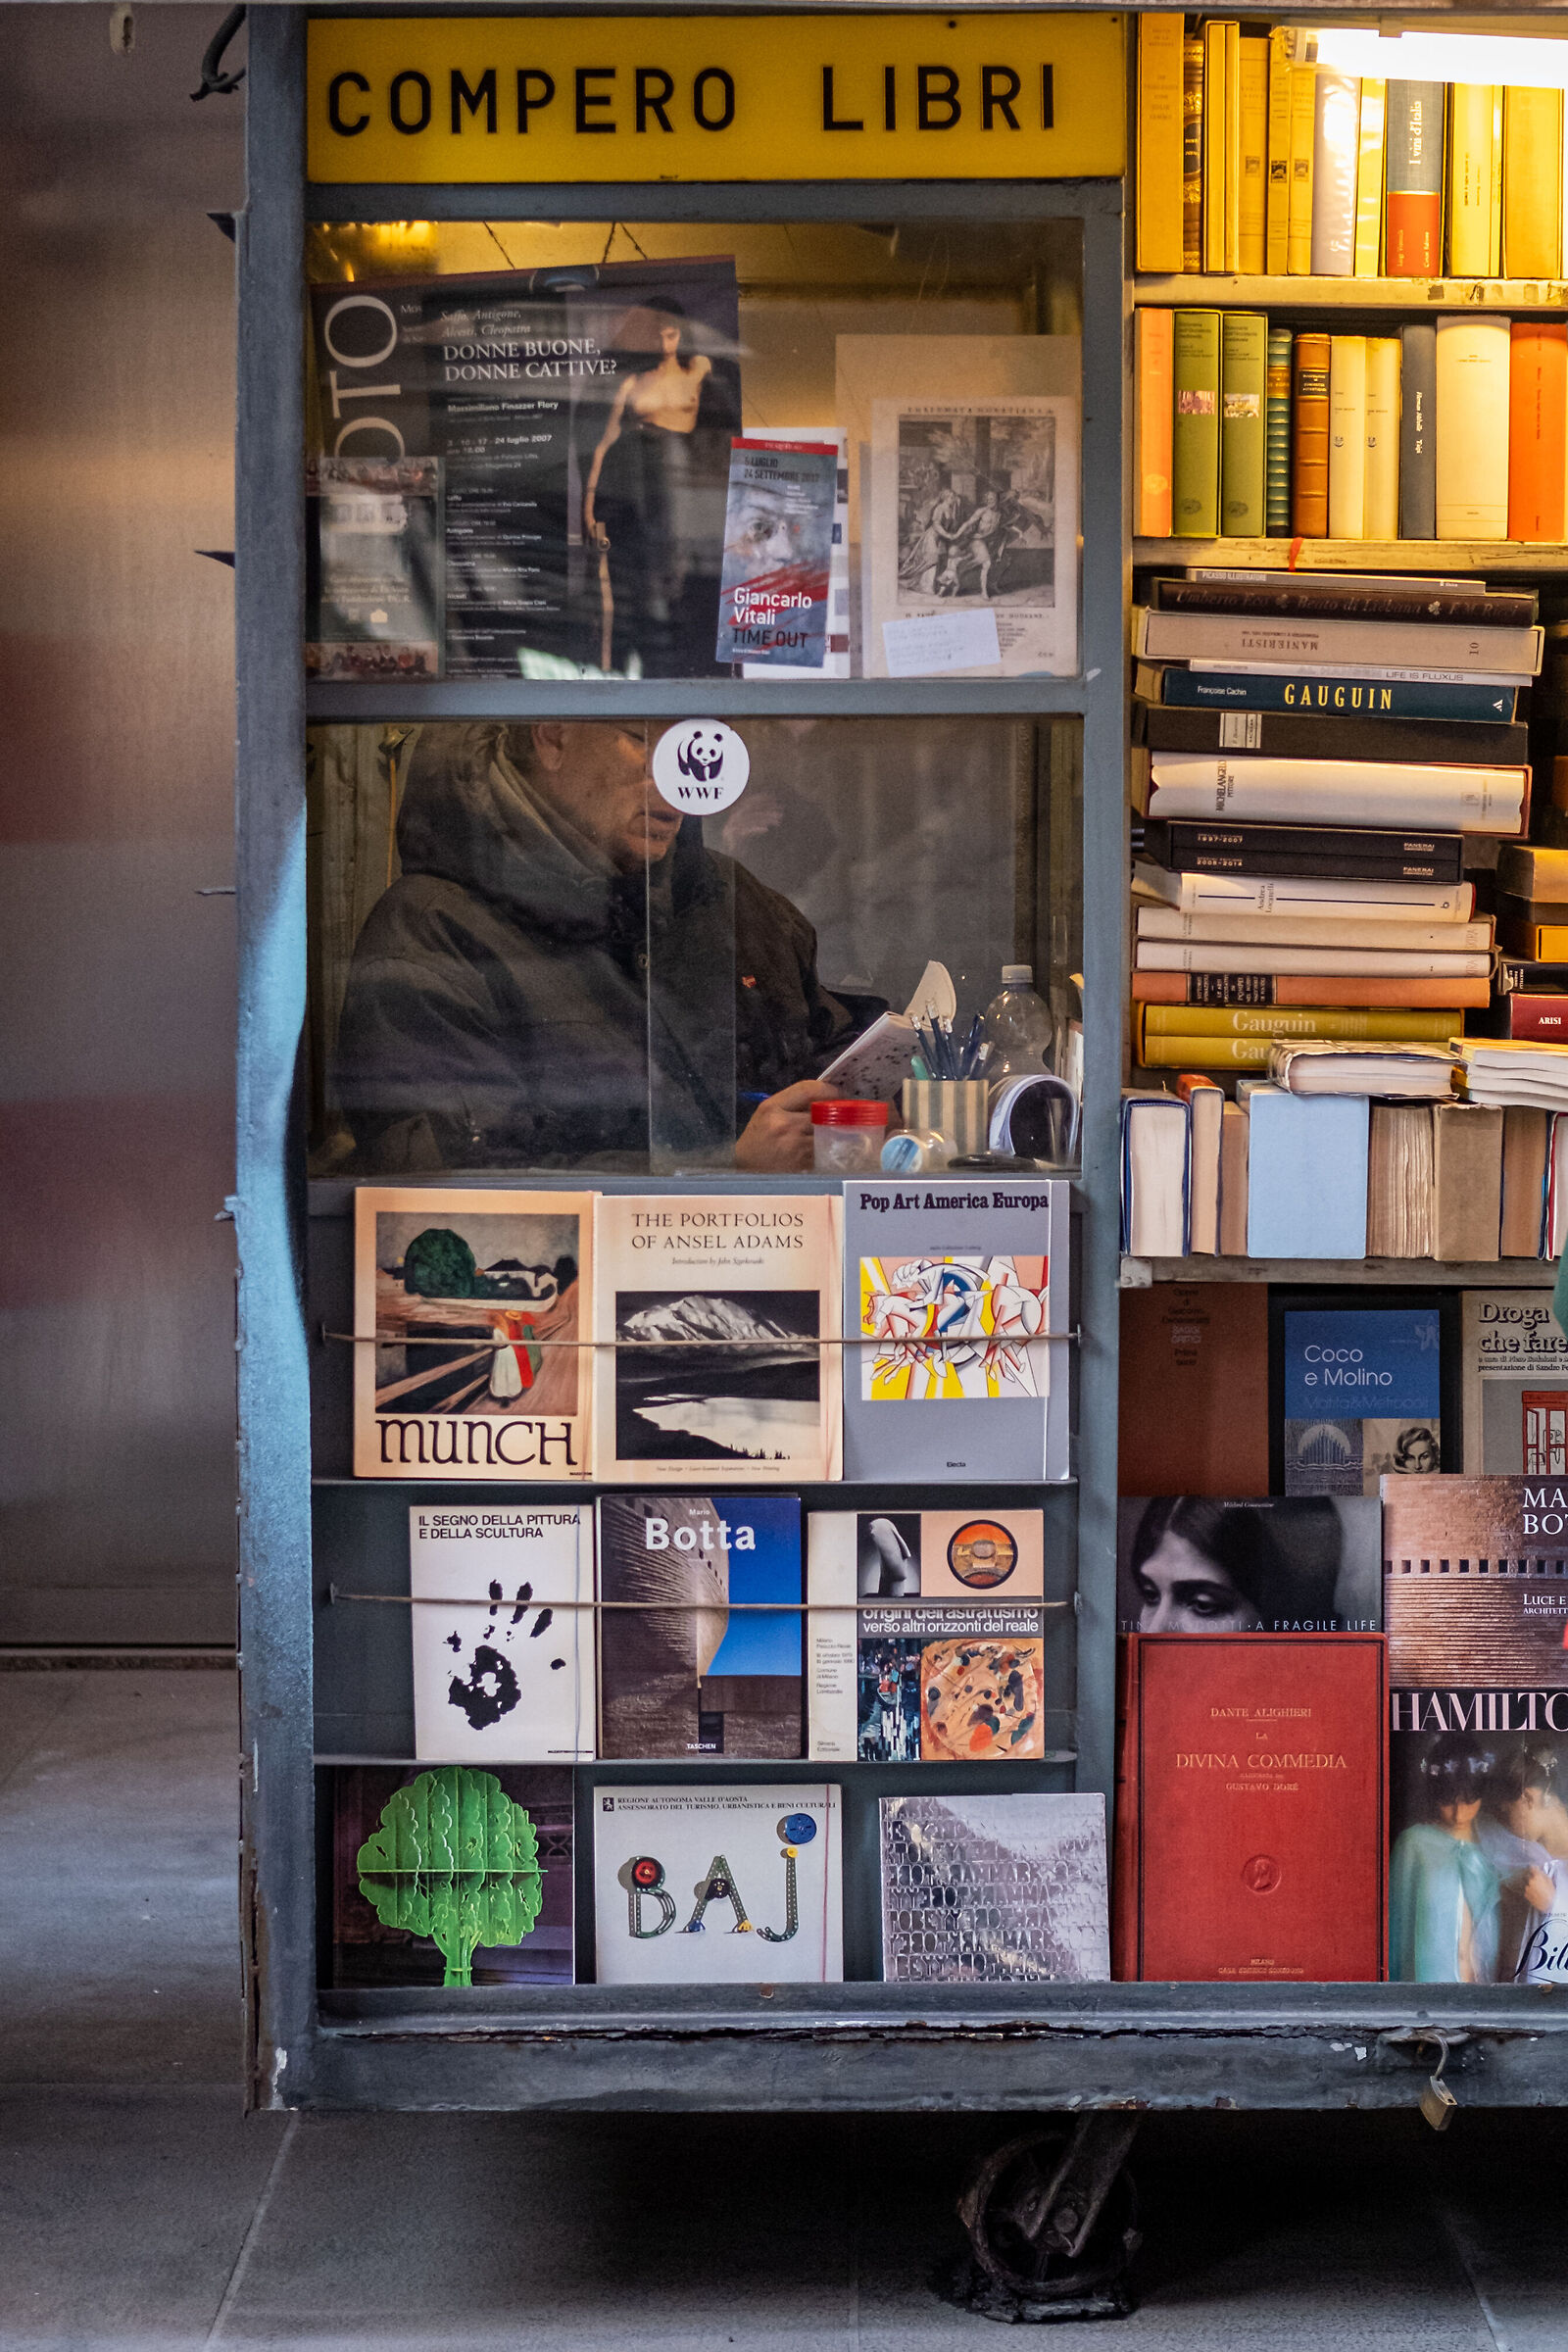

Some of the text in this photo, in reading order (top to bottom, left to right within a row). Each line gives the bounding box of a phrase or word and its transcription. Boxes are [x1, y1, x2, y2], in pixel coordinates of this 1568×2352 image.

[328, 64, 1054, 136] COMPERO LIBRI
[1410, 138, 1422, 157] vini
[481, 324, 530, 337] Cleopatra
[444, 338, 601, 361] DONNE BUONE,
[445, 360, 617, 381] DONNE CATTIVE?
[507, 435, 530, 445] luglio
[531, 434, 553, 443] 2007
[751, 457, 778, 468] LUGLIO
[745, 468, 799, 481] 24 SETTEMBRE
[1201, 571, 1226, 580] PICASSO
[735, 587, 812, 610] Giancarlo
[1176, 590, 1237, 606] Umberto
[1343, 597, 1358, 612] di
[735, 607, 775, 625] Vitali
[732, 627, 808, 649] TIME OUT
[1242, 638, 1319, 652] MANIERISTI
[1470, 642, 1479, 656] 10
[1386, 670, 1407, 679] LIFE
[1226, 686, 1248, 696] Cachin
[1284, 684, 1393, 710] GAUGUIN
[1216, 760, 1227, 811] MICHELANGELO
[677, 786, 724, 800] WWF
[1233, 1010, 1317, 1038] Gauguin
[860, 1192, 1049, 1212] Pop Art America Europa
[632, 1213, 804, 1227] THE PORTFOLIOS
[632, 1235, 804, 1249] OF ANSEL ADAMS
[672, 1256, 731, 1266] Introduction by John
[1479, 1301, 1549, 1330] Droga
[1478, 1330, 1568, 1352] che fare
[1304, 1345, 1363, 1362] Coco
[1478, 1363, 1526, 1372] presentazione
[1304, 1368, 1393, 1386] e Molino
[418, 1514, 580, 1526] IL SEGNO DELLA PITTURA
[418, 1527, 543, 1539] E DELLA SCULTURA
[645, 1517, 756, 1550] Botta
[1524, 1593, 1566, 1605] LUCE E
[863, 1619, 1039, 1632] verso altri orizzonti del reale
[1255, 1620, 1264, 1631] A
[1274, 1620, 1337, 1631] FRAGILE
[1347, 1620, 1376, 1631] LIFE
[1210, 1707, 1311, 1717] DANTE ALIGHIERI
[1390, 1691, 1568, 1732] HAMILTO
[1176, 1753, 1348, 1768] DIVINA COMMEDIA
[1273, 1782, 1299, 1790] DORÉ
